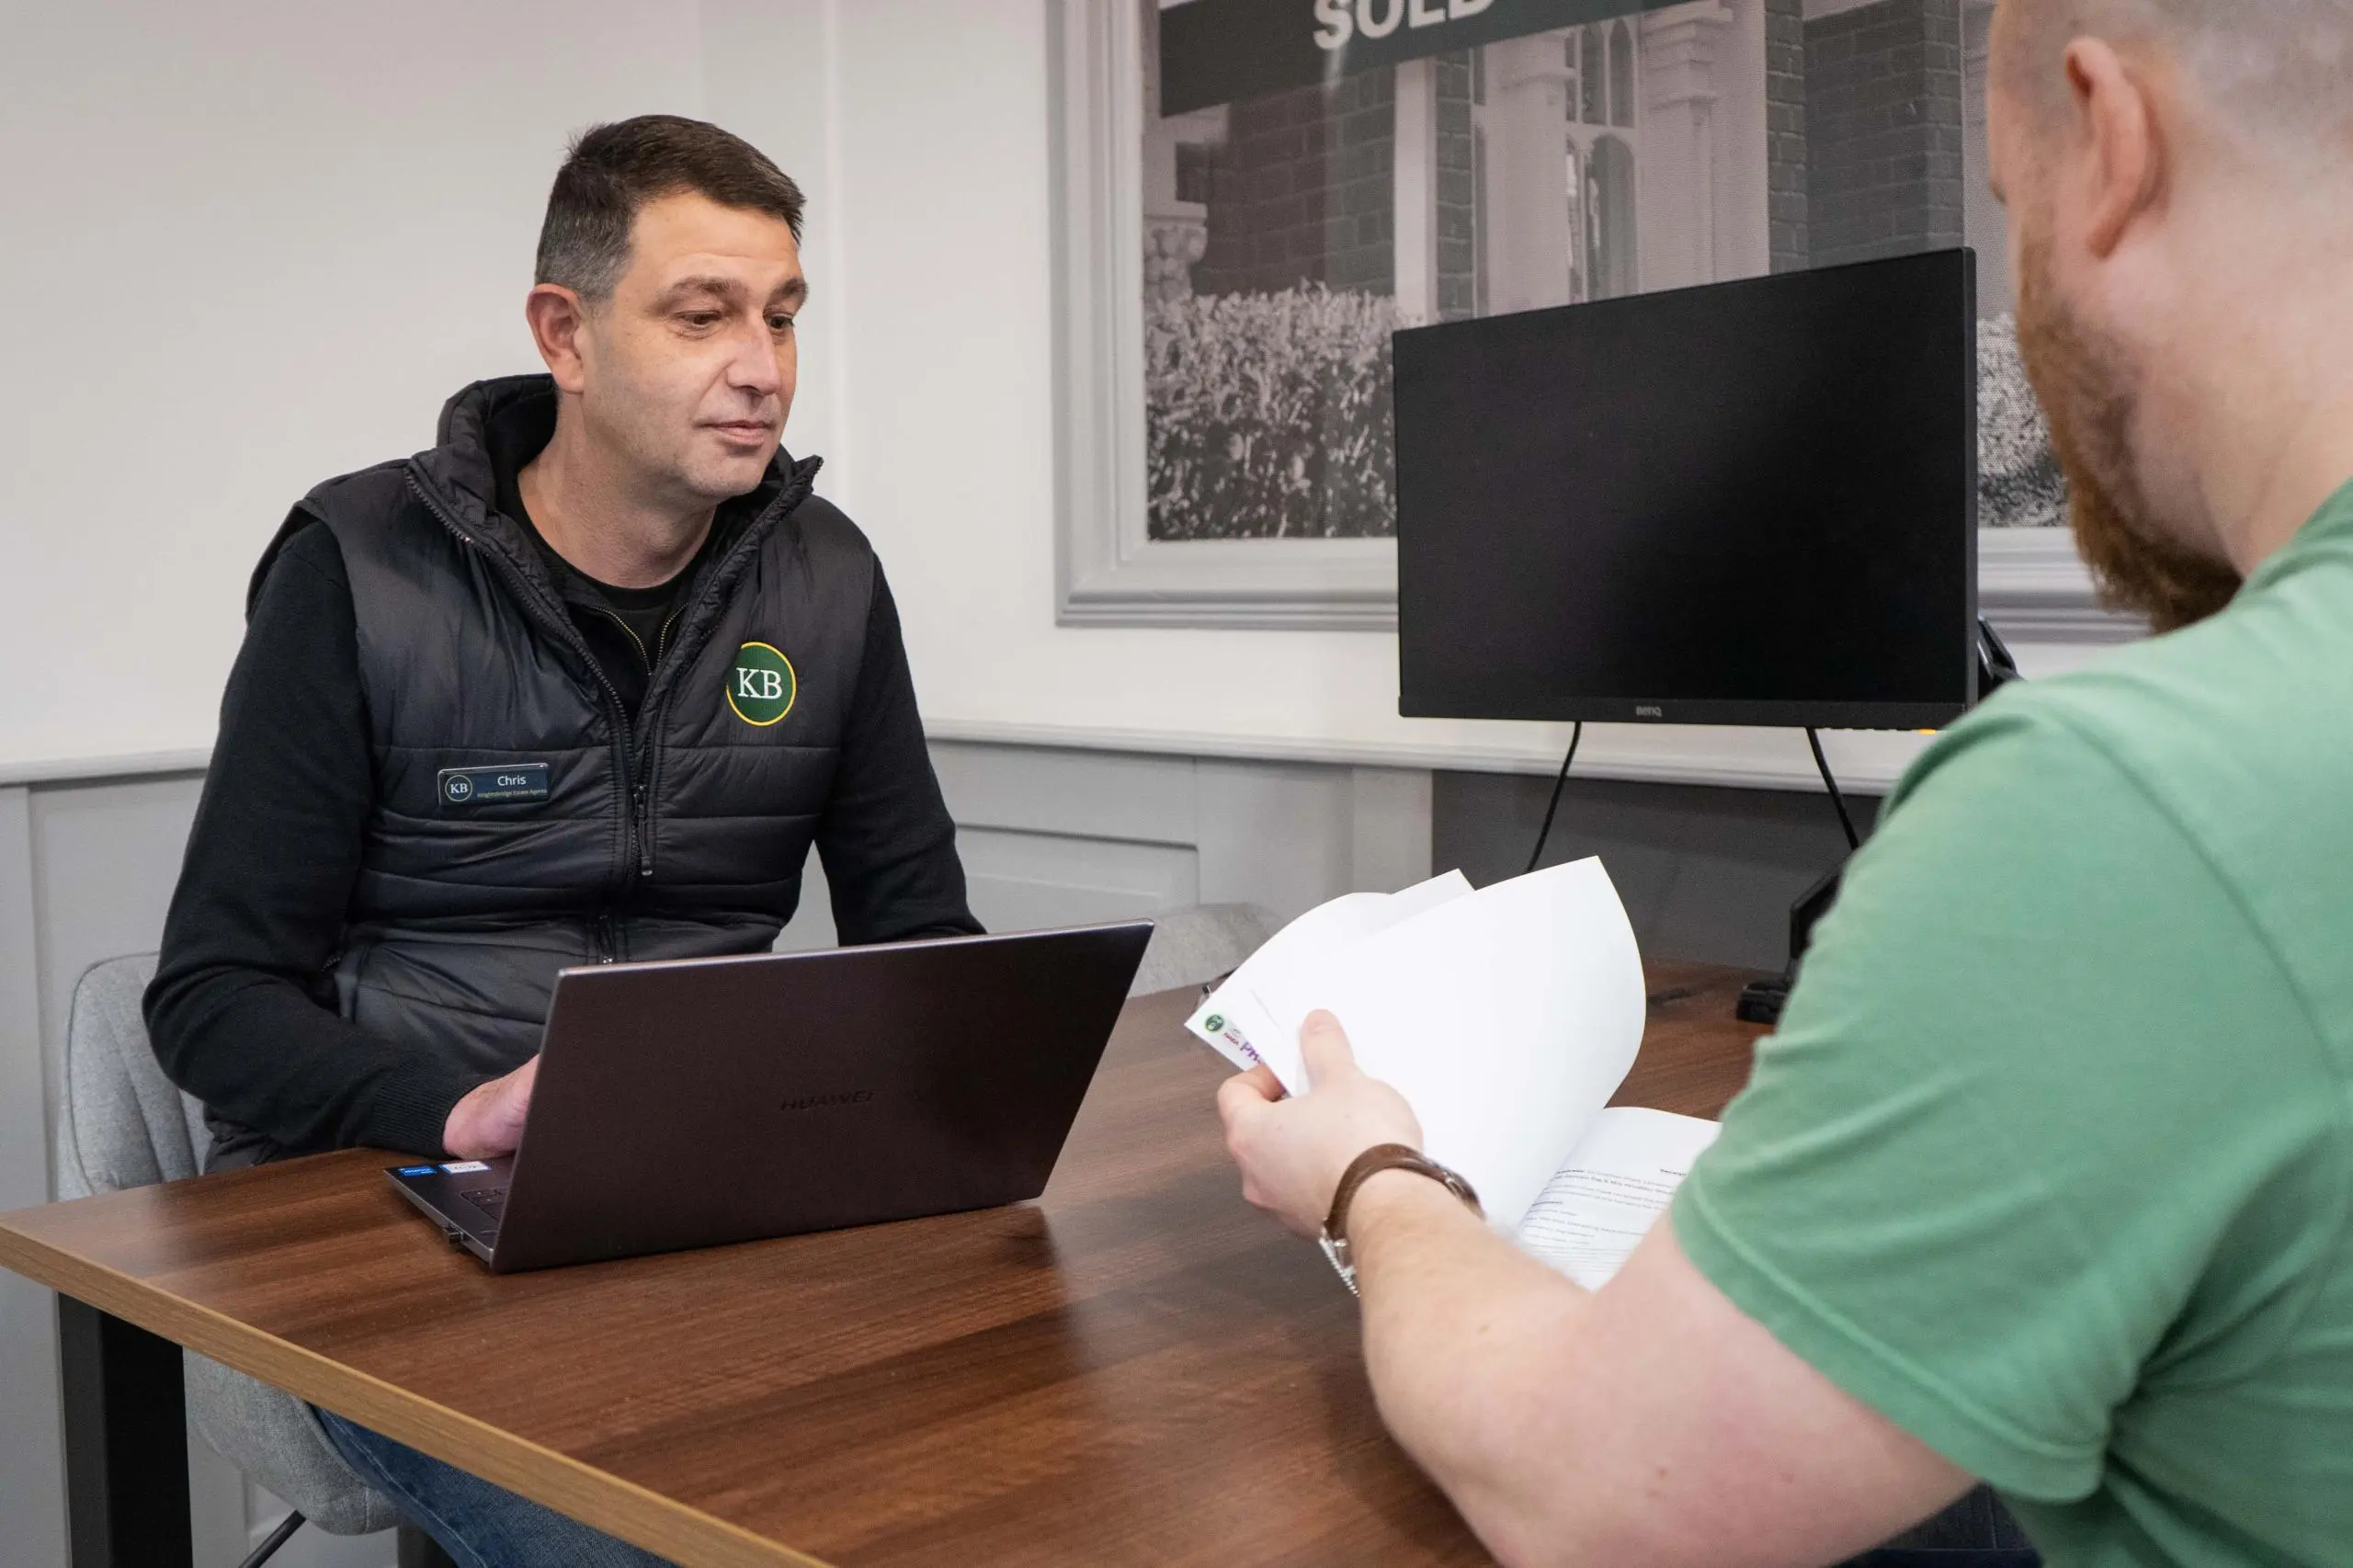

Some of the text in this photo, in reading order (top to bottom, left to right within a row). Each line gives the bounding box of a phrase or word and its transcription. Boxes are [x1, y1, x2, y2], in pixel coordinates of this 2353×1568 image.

[736, 667, 782, 699] KB
[497, 775, 527, 786] Chris
[450, 783, 469, 794] KB
[780, 1090, 874, 1110] HUAWEI
